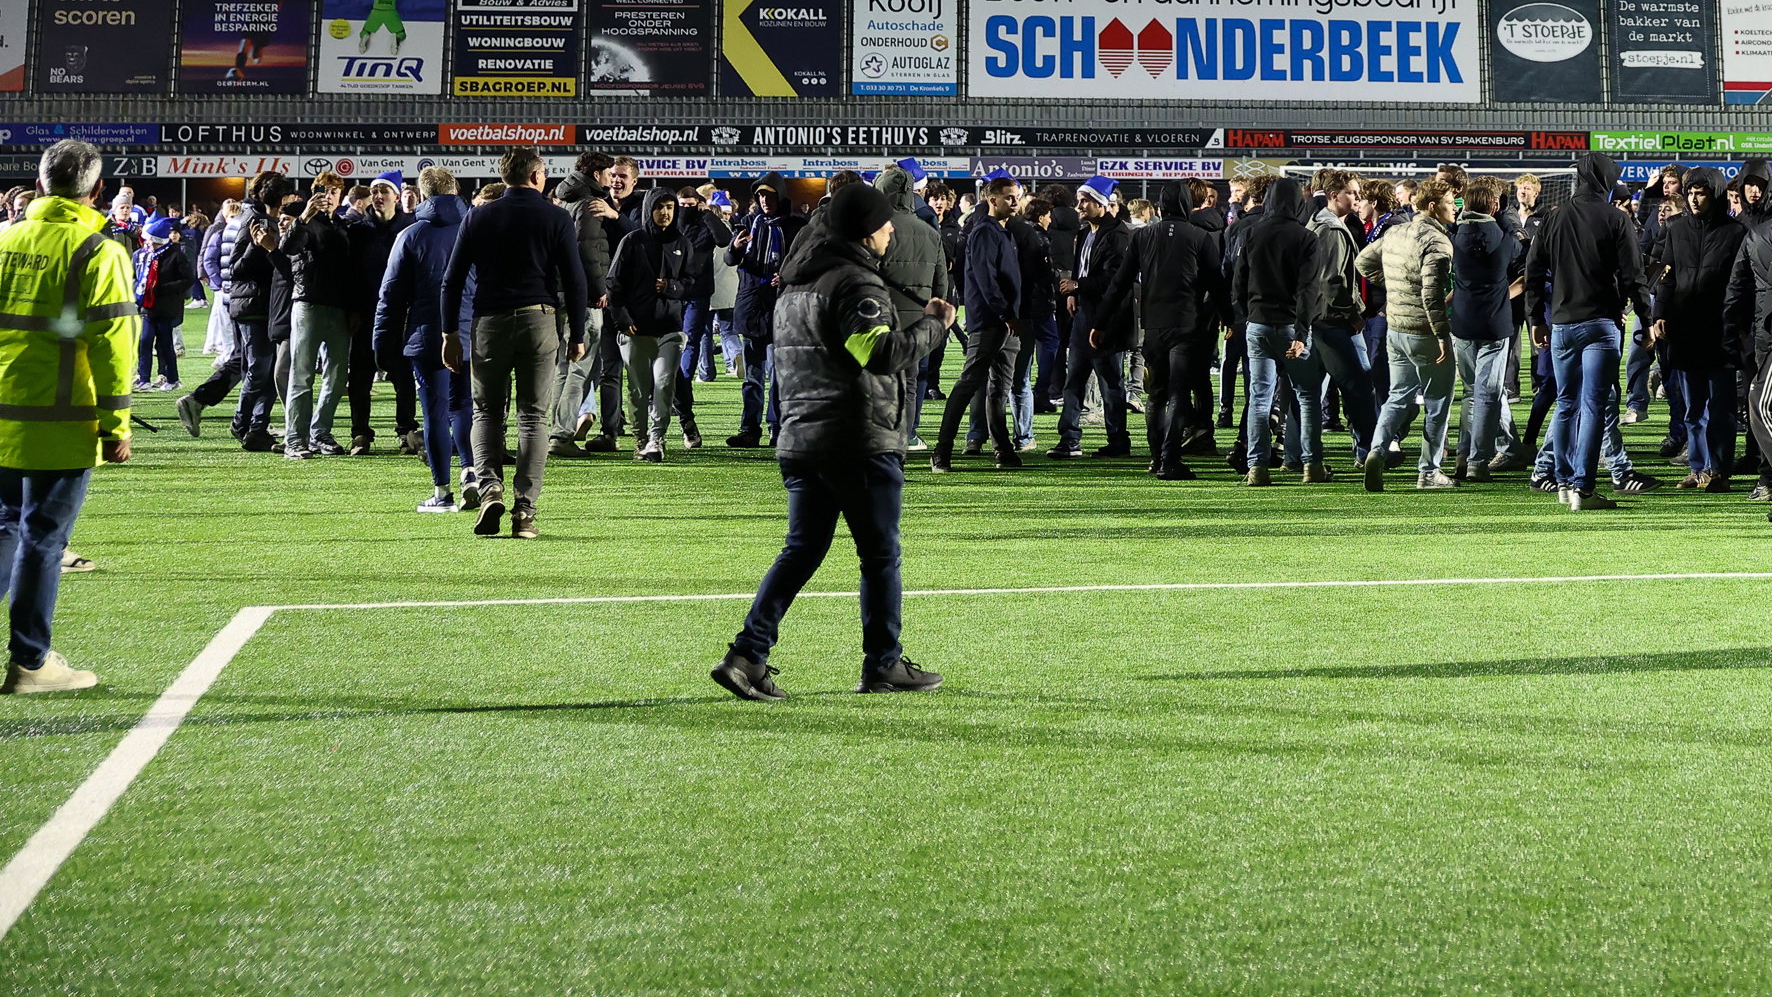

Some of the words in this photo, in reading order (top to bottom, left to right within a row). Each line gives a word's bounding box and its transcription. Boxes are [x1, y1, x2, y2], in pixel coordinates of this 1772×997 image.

[214, 3, 279, 12] TREFZEKER
[1619, 0, 1636, 12] De
[1640, 2, 1700, 13] warmste
[54, 10, 135, 25] scoren
[214, 13, 227, 22] IN
[229, 13, 278, 22] ENERGIE
[461, 15, 573, 26] UTILITEITSBOUW
[614, 12, 686, 20] PRESTEREN
[1619, 15, 1669, 27] bakker
[1671, 18, 1700, 28] van
[214, 23, 278, 32] BESPARING
[868, 20, 944, 31] Autoschade
[601, 28, 698, 36] HOOGSPANNING
[1522, 24, 1586, 40] STOEPJE
[1628, 31, 1644, 42] de
[1650, 31, 1692, 42] markt
[467, 37, 566, 48] WONINGBOUW
[860, 36, 928, 48] ONDERHOUD
[478, 59, 554, 70] RENOVATIE
[892, 56, 950, 70] AUTOGLAZ
[1628, 53, 1696, 66] stoepje.nl
[50, 67, 66, 76] NO
[50, 75, 84, 84] BEARS
[458, 81, 570, 93] SBAGROEP.NL
[26, 126, 50, 135] Glas
[54, 124, 64, 134] &
[70, 126, 147, 136] Schilderwerken
[162, 126, 282, 142] LOFTHUS
[450, 125, 565, 141] voetbalshop.nl
[585, 126, 699, 142] voetbalshop.nl
[753, 127, 841, 145] ANTONIO'S
[848, 127, 929, 145] EETHUYS
[980, 130, 1026, 144] Blitz.
[1036, 132, 1130, 143] TRAPRENOVATIE
[1135, 133, 1142, 143] &
[1147, 133, 1200, 143] VLOEREN
[1227, 130, 1285, 148] HAPAM
[1291, 135, 1330, 144] TROTSE
[1332, 135, 1416, 144] JEUGDSPONSOR
[1418, 136, 1438, 144] VAN
[1440, 136, 1454, 144] SV
[1456, 136, 1525, 145] SPAKENBURG
[1530, 132, 1586, 150] HAPAM
[1594, 134, 1735, 151] TextielPlaat.nl
[167, 157, 248, 174] Mink's
[360, 159, 378, 167] Van
[380, 159, 404, 167] Gent
[442, 159, 460, 167] Van
[462, 159, 486, 167] Gent
[686, 160, 707, 169] BV
[710, 158, 767, 167] Intraboss
[802, 159, 859, 167] Intraboss
[1100, 161, 1130, 170] GZK
[1134, 161, 1197, 171] SERVICE
[1201, 162, 1222, 171] BV
